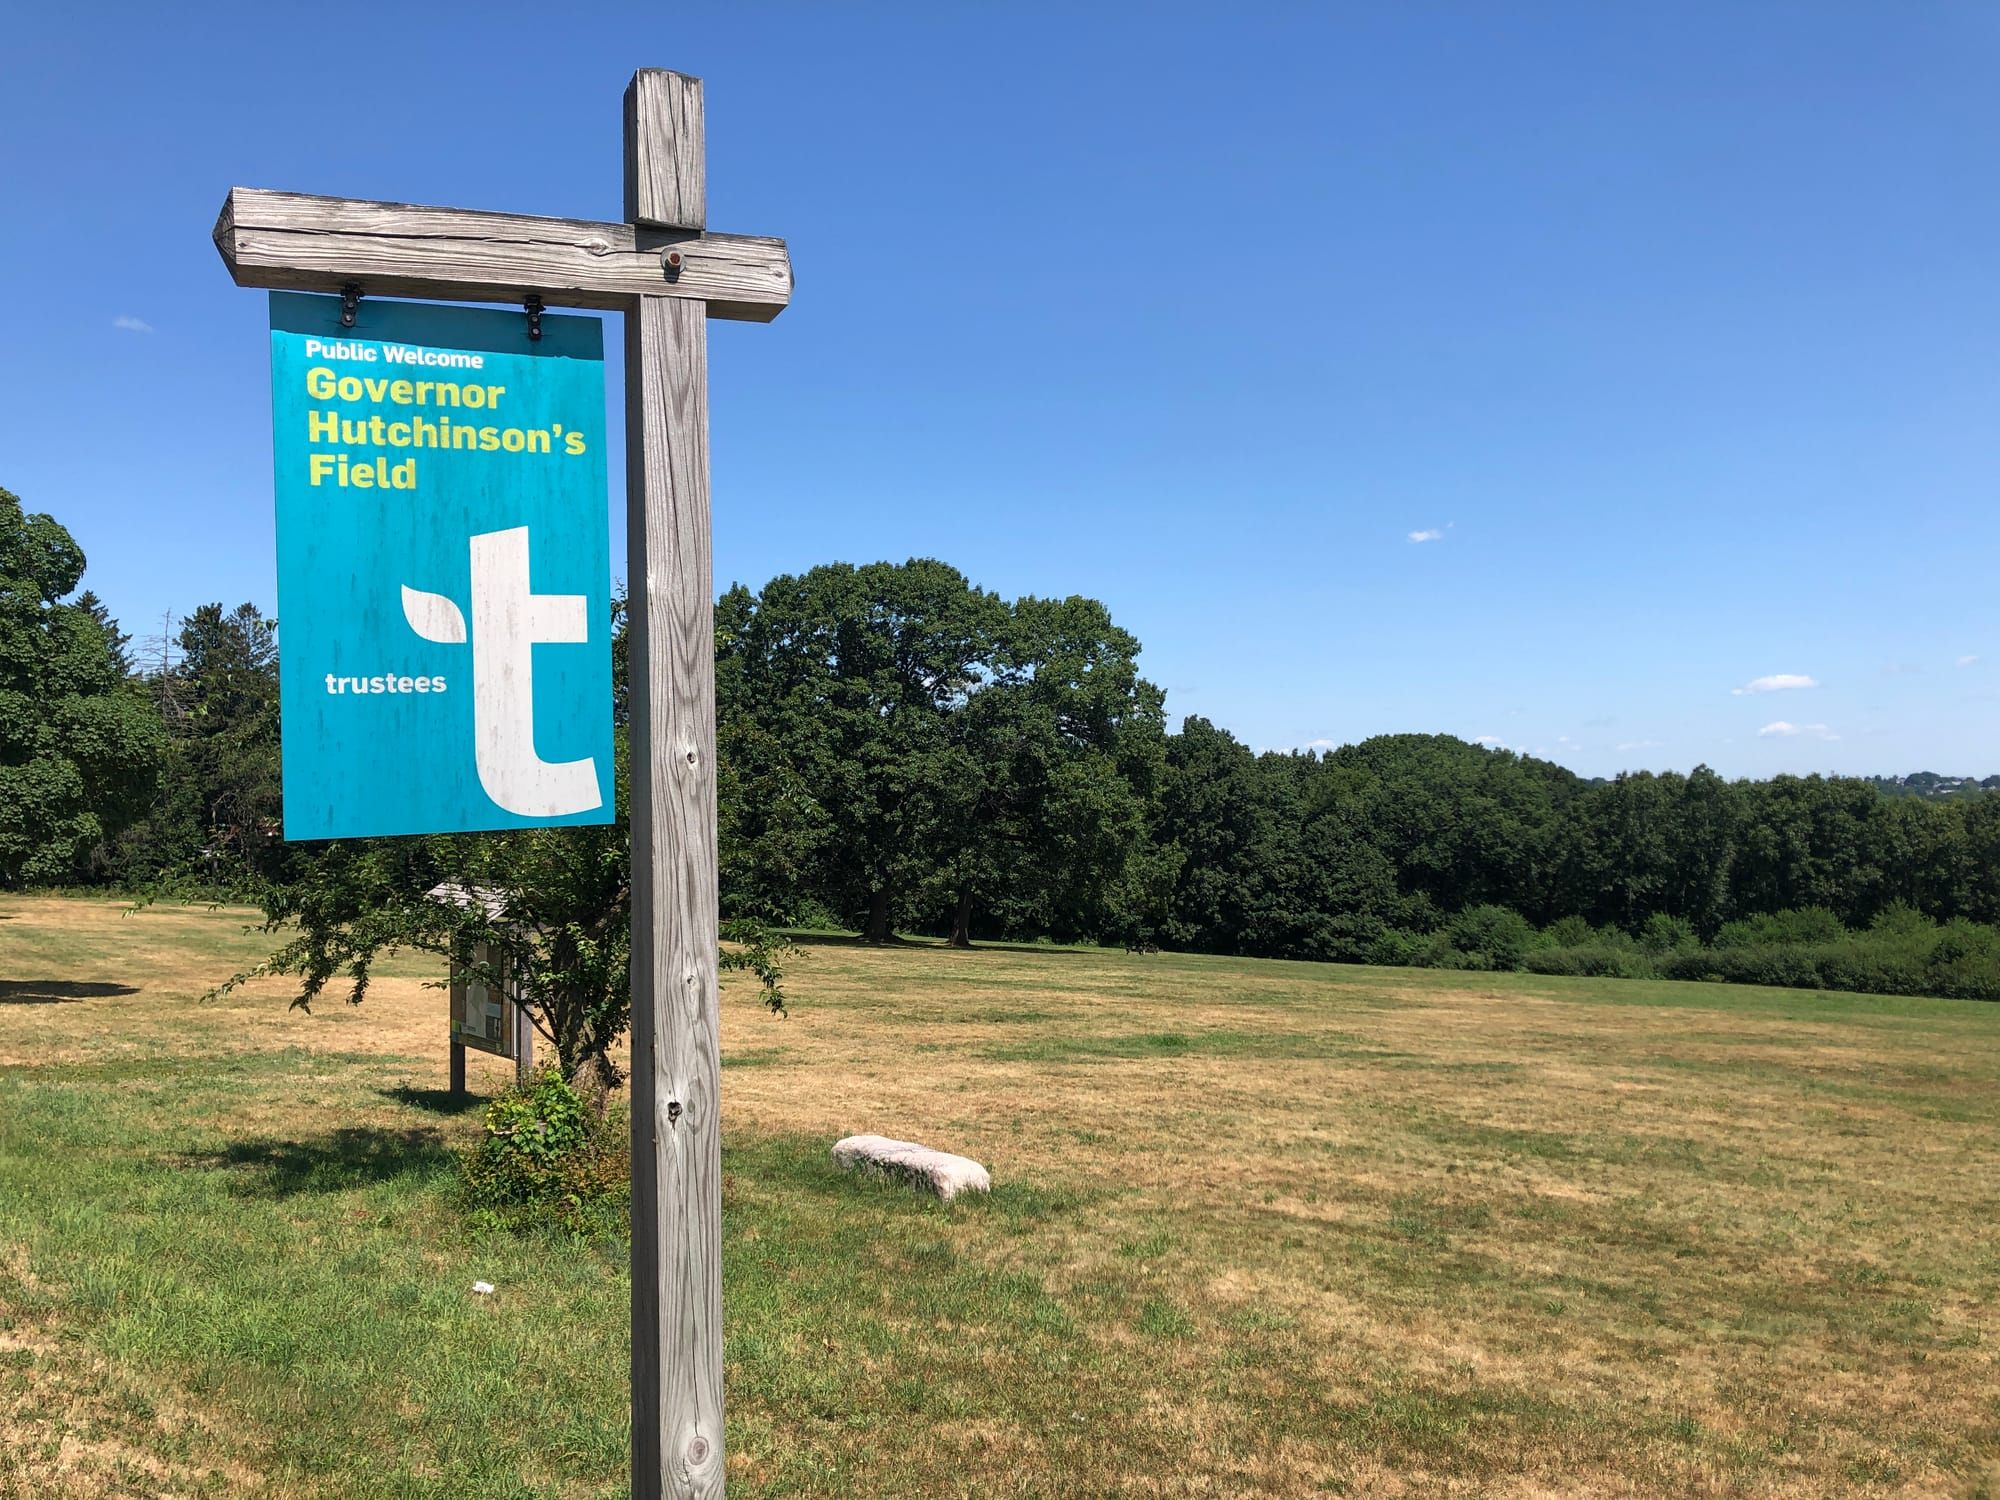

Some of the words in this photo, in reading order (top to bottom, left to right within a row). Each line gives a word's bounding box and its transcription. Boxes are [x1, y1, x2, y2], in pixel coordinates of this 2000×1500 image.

[305, 339, 378, 362] Public
[382, 345, 484, 369] Welcome
[306, 367, 506, 409] Governor
[309, 454, 417, 490] Field
[325, 673, 448, 694] trustees
[469, 526, 602, 817] t
